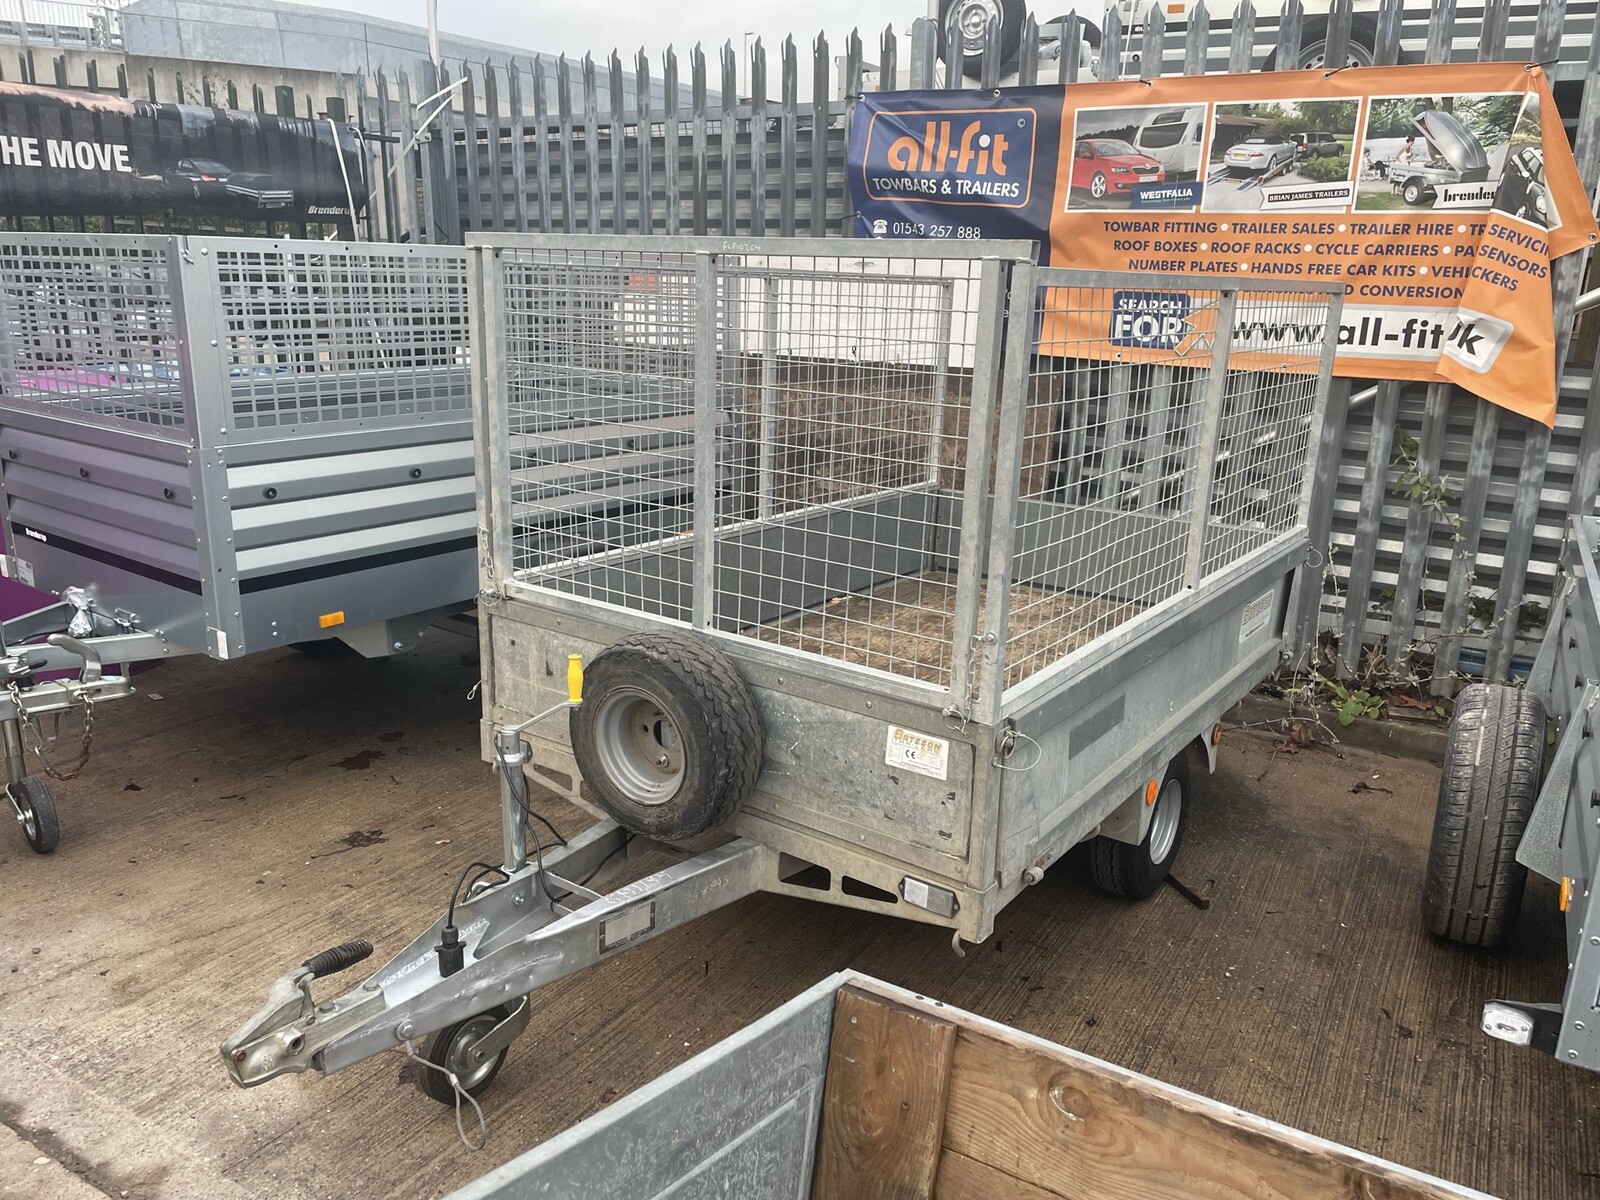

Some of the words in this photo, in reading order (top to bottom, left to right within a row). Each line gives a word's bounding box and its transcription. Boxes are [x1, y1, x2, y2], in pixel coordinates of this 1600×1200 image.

[0, 135, 42, 166] HE
[46, 139, 132, 172] MOVE
[887, 120, 1008, 175] all-fit
[873, 178, 936, 194] TOWBARS
[941, 179, 952, 194] &
[956, 180, 1020, 197] TRAILERS
[1140, 188, 1193, 200] WESTFALIA
[1269, 194, 1290, 202] BRIAN
[1290, 192, 1313, 201] JAMES
[1314, 189, 1348, 198] TRAILERS
[308, 205, 355, 215] Brenderu
[893, 223, 925, 235] 01543
[930, 225, 952, 237] 257
[957, 227, 981, 239] 888
[1103, 221, 1159, 232] TOWBAR
[1163, 222, 1218, 234] FITTING
[1231, 223, 1287, 234] TRAILER
[1291, 223, 1335, 235] SALES
[1350, 223, 1413, 235] TRAILER
[1416, 224, 1454, 236] HIRE
[1113, 240, 1150, 251] ROOF
[1153, 241, 1198, 253] BOXES
[1210, 242, 1251, 253] ROOF
[1254, 242, 1301, 254] RACKS
[1315, 243, 1359, 255] CYCLE
[1364, 244, 1439, 257] CARRIERS
[1454, 245, 1479, 257] PA
[1128, 259, 1186, 272] NUMBER
[1190, 261, 1238, 273] PLATES
[1251, 262, 1303, 274] HANDS
[1308, 263, 1342, 275] FREE
[1347, 264, 1379, 276] CAR
[1382, 264, 1416, 277] KITS
[1432, 265, 1472, 278] VEHI
[1478, 244, 1548, 279] SENSORS
[1471, 265, 1519, 291] CKERS
[1118, 298, 1183, 314] SEARCH
[1114, 314, 1184, 343] FOR
